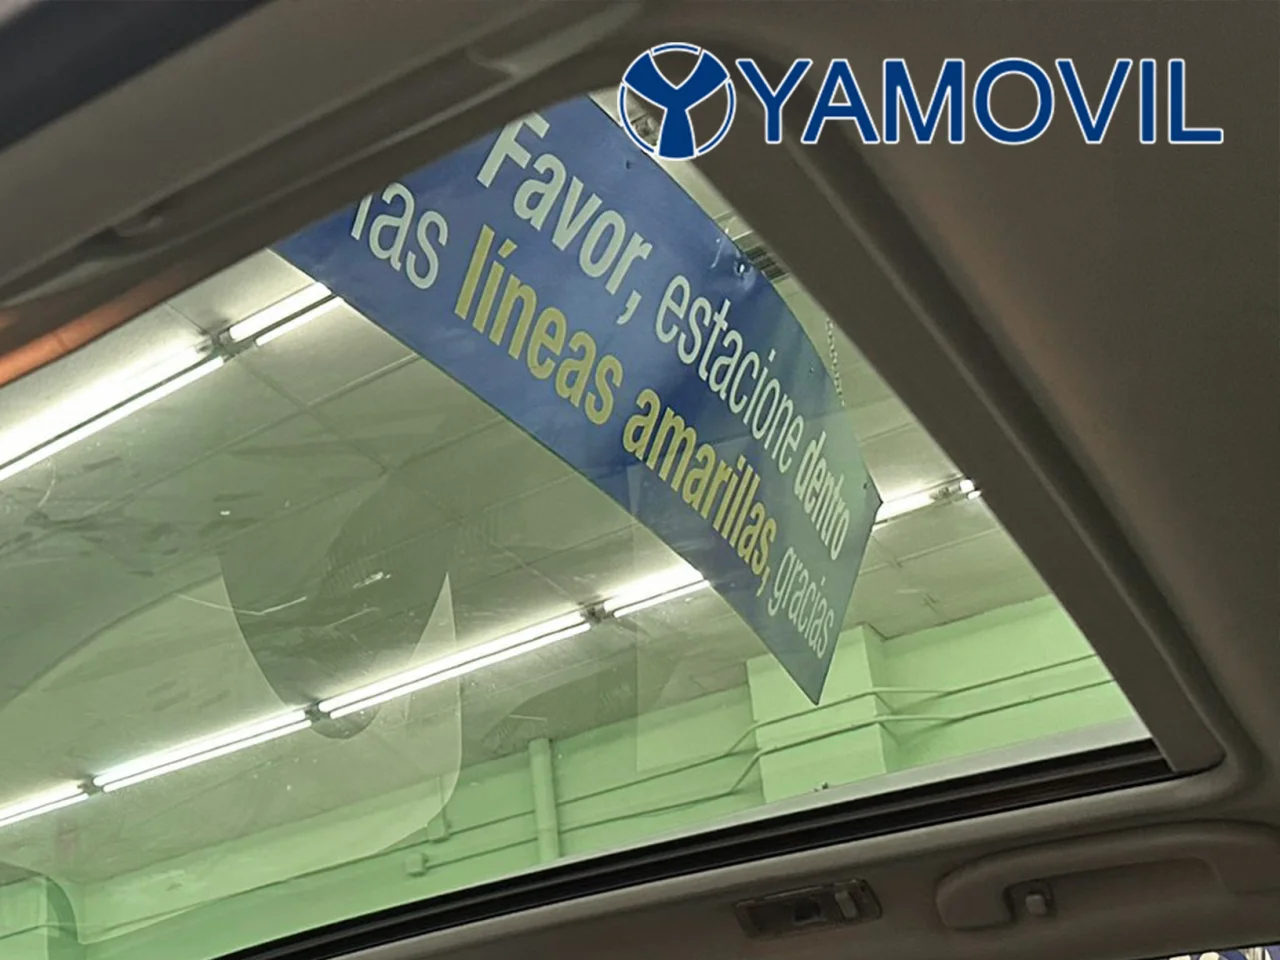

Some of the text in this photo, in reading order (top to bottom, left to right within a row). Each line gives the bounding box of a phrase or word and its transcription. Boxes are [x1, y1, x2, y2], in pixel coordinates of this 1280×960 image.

[454, 223, 624, 425] líneas
[623, 387, 777, 597] amarillas,
[767, 546, 835, 660] gracias
[476, 111, 850, 561] Favor, estacione dentro
